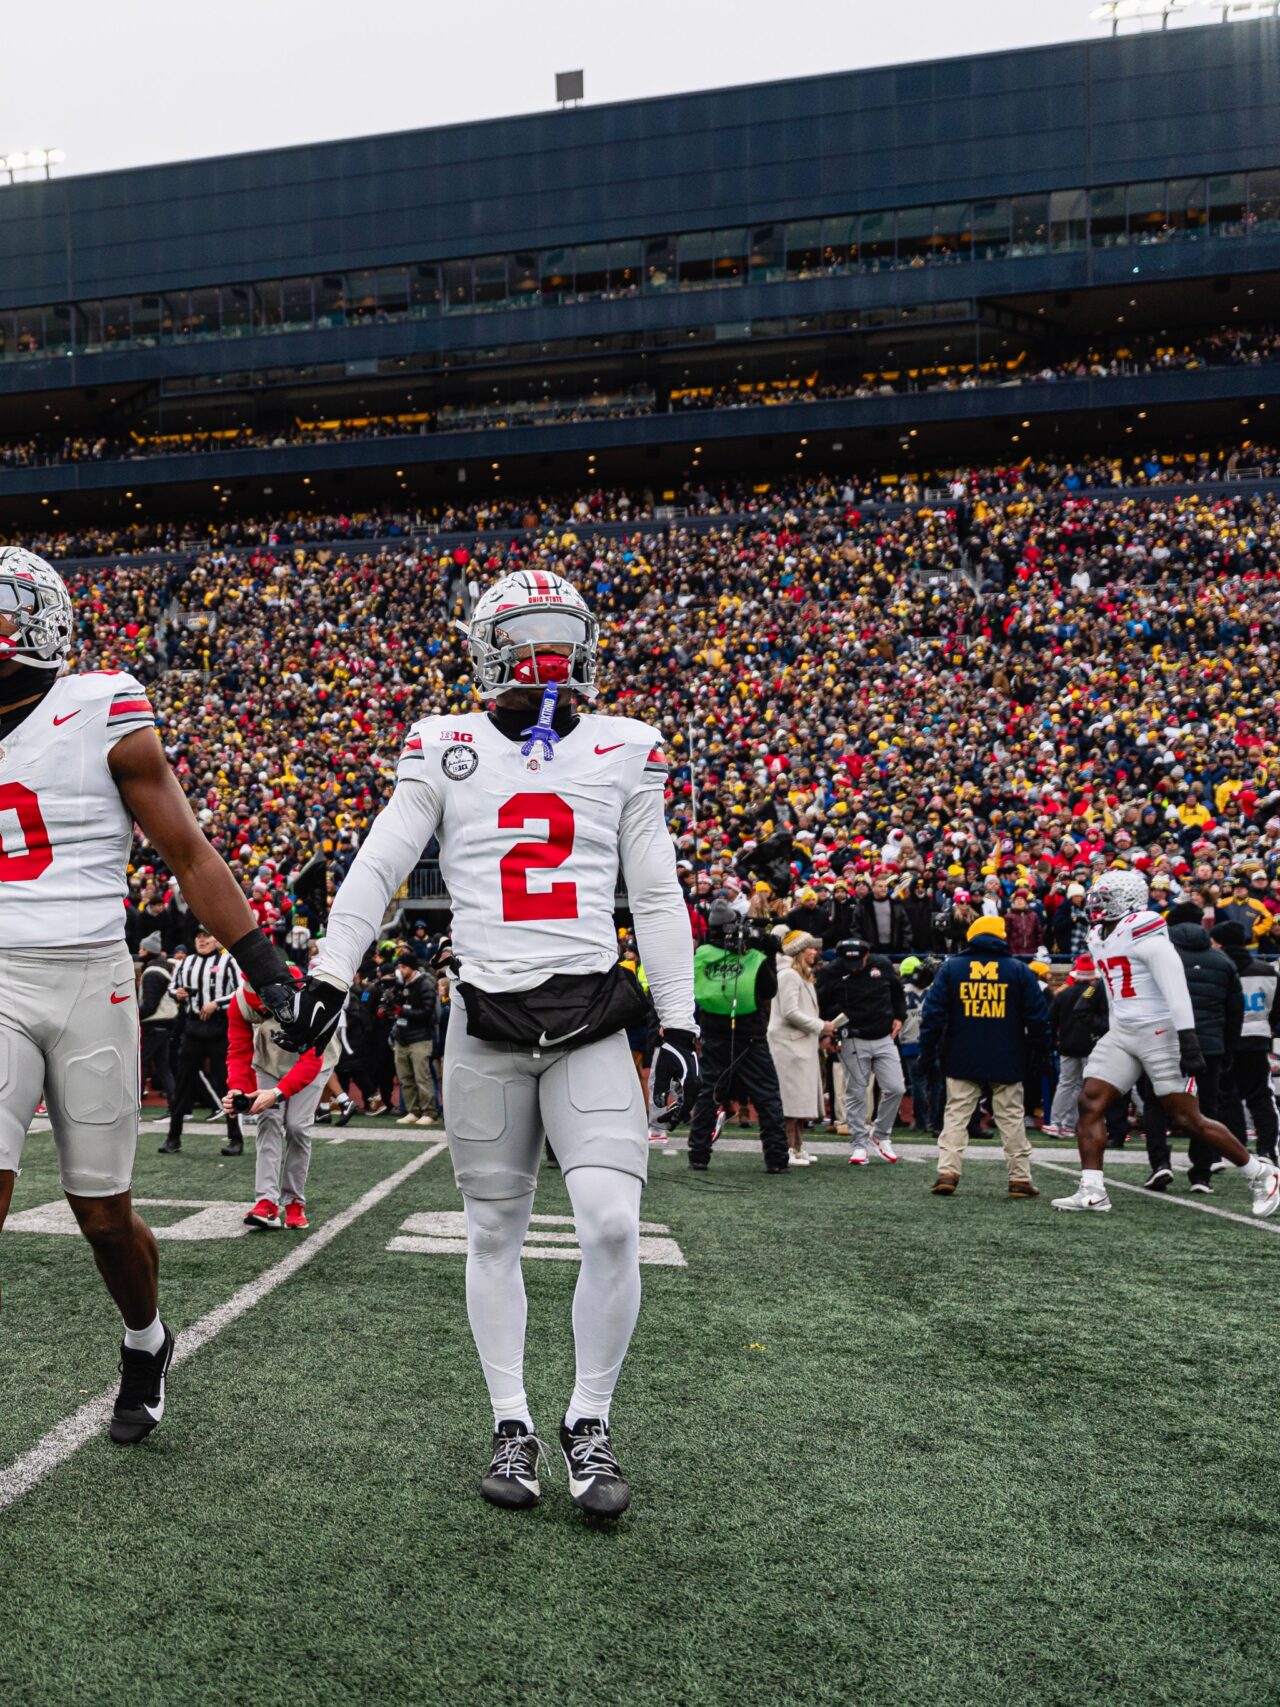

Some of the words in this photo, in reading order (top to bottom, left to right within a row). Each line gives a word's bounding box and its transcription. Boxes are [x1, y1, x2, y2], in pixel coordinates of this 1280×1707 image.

[539, 698, 555, 725] NXTRND
[498, 793, 579, 922] 2
[969, 961, 999, 980] M
[960, 982, 1008, 1000] EVENT
[963, 1000, 1005, 1018] TEAM
